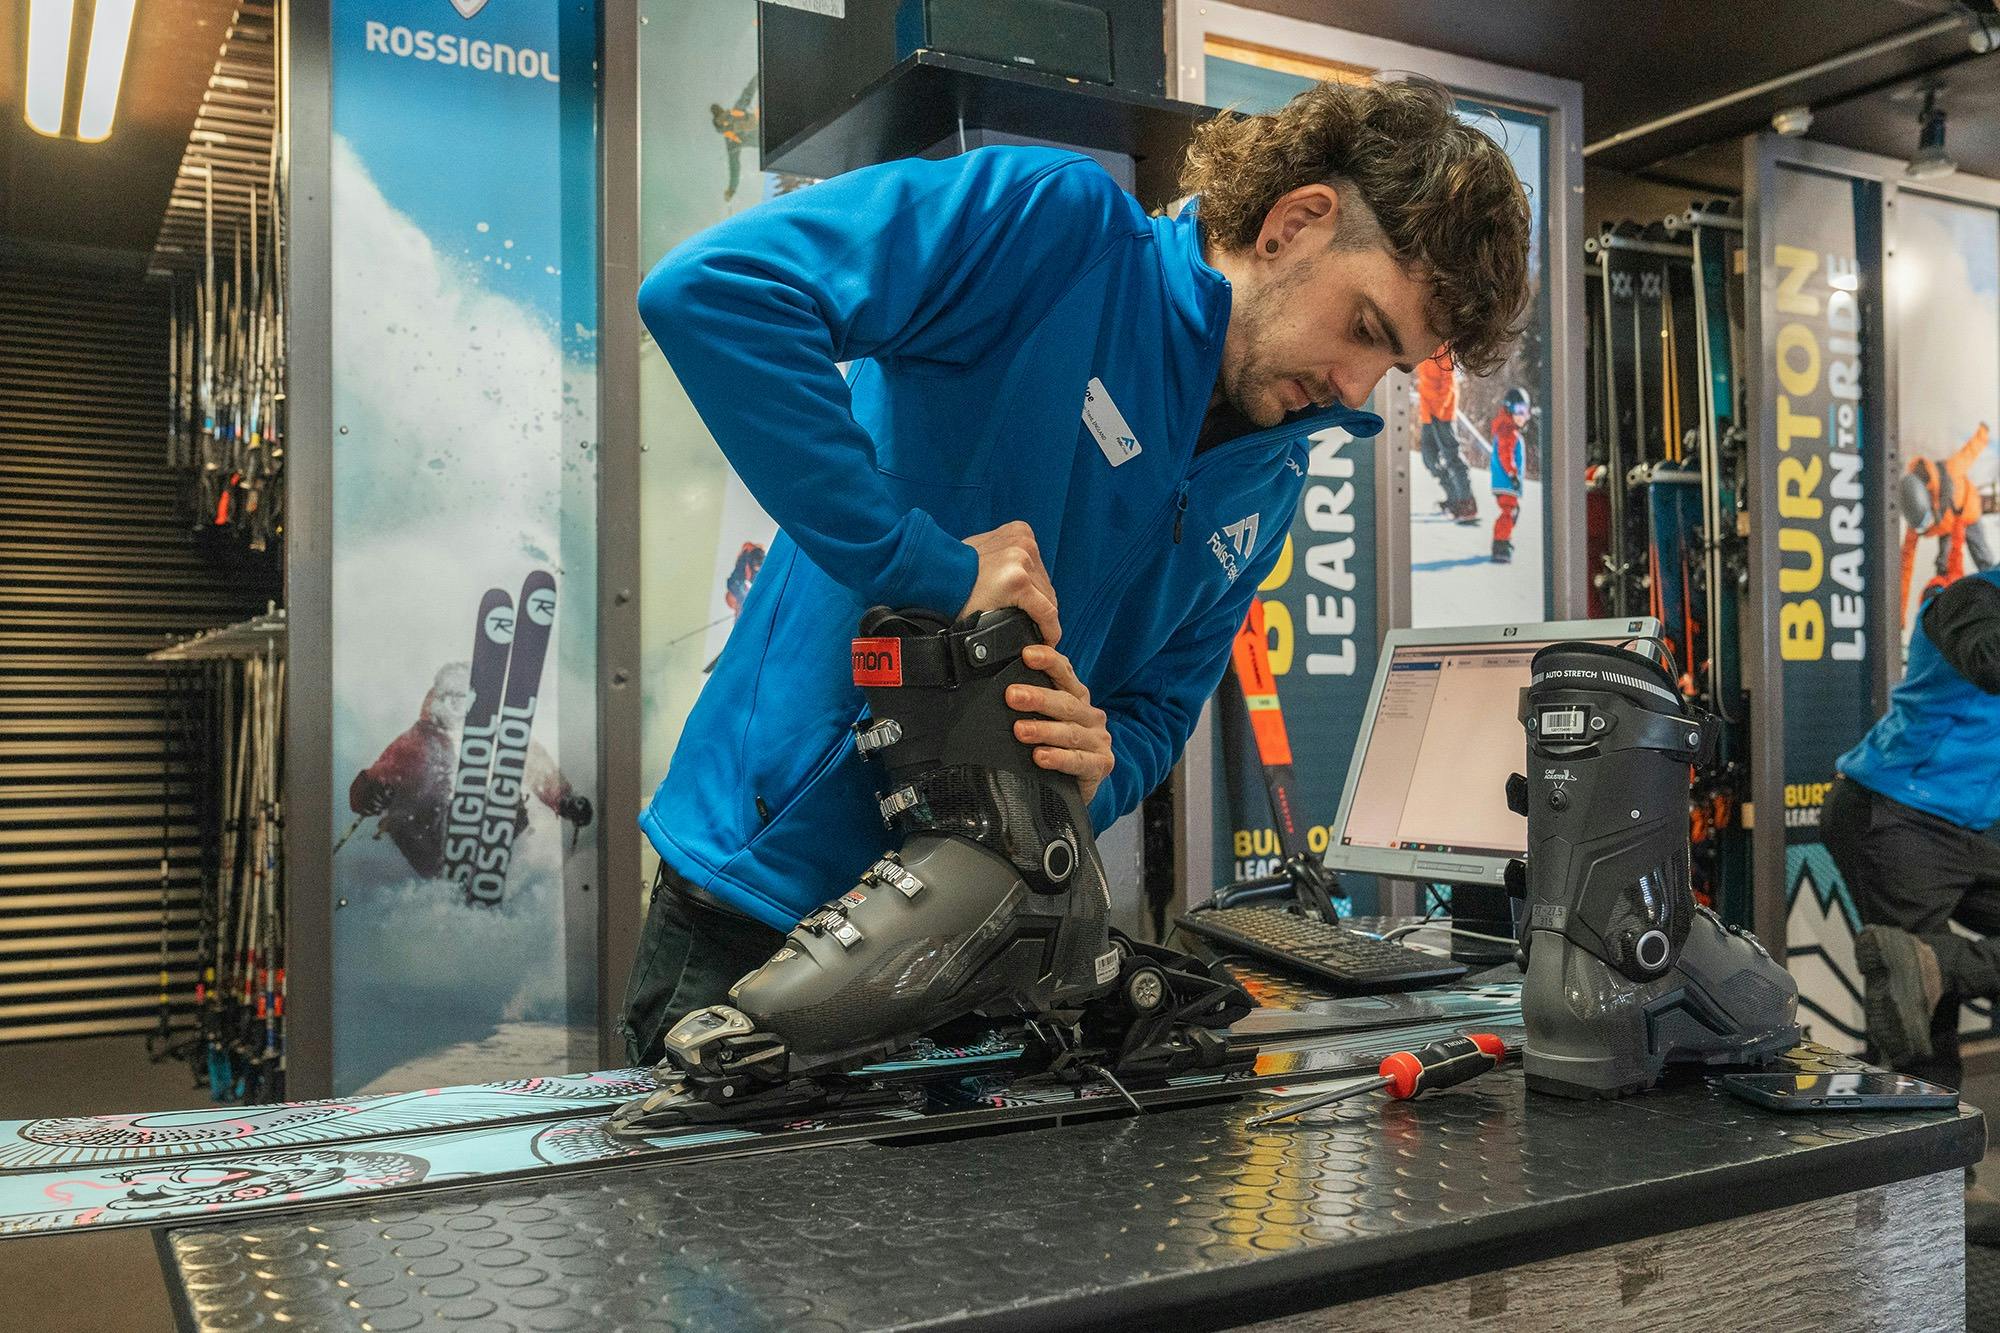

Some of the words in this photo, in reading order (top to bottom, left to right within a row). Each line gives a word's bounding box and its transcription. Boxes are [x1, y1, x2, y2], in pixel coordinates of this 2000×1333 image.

[366, 21, 560, 83] ROSSIGNOL
[1084, 387, 1095, 402] oe
[1827, 253, 1863, 400] RIDE
[1774, 245, 1825, 661] BURTON
[1837, 404, 1855, 449] TO
[1304, 426, 1357, 676] LEARN
[1829, 451, 1866, 661] LEARN
[1545, 671, 1563, 680] AUTO
[1563, 670, 1598, 679] STRETCH
[470, 696, 536, 906] OSSIGNOL
